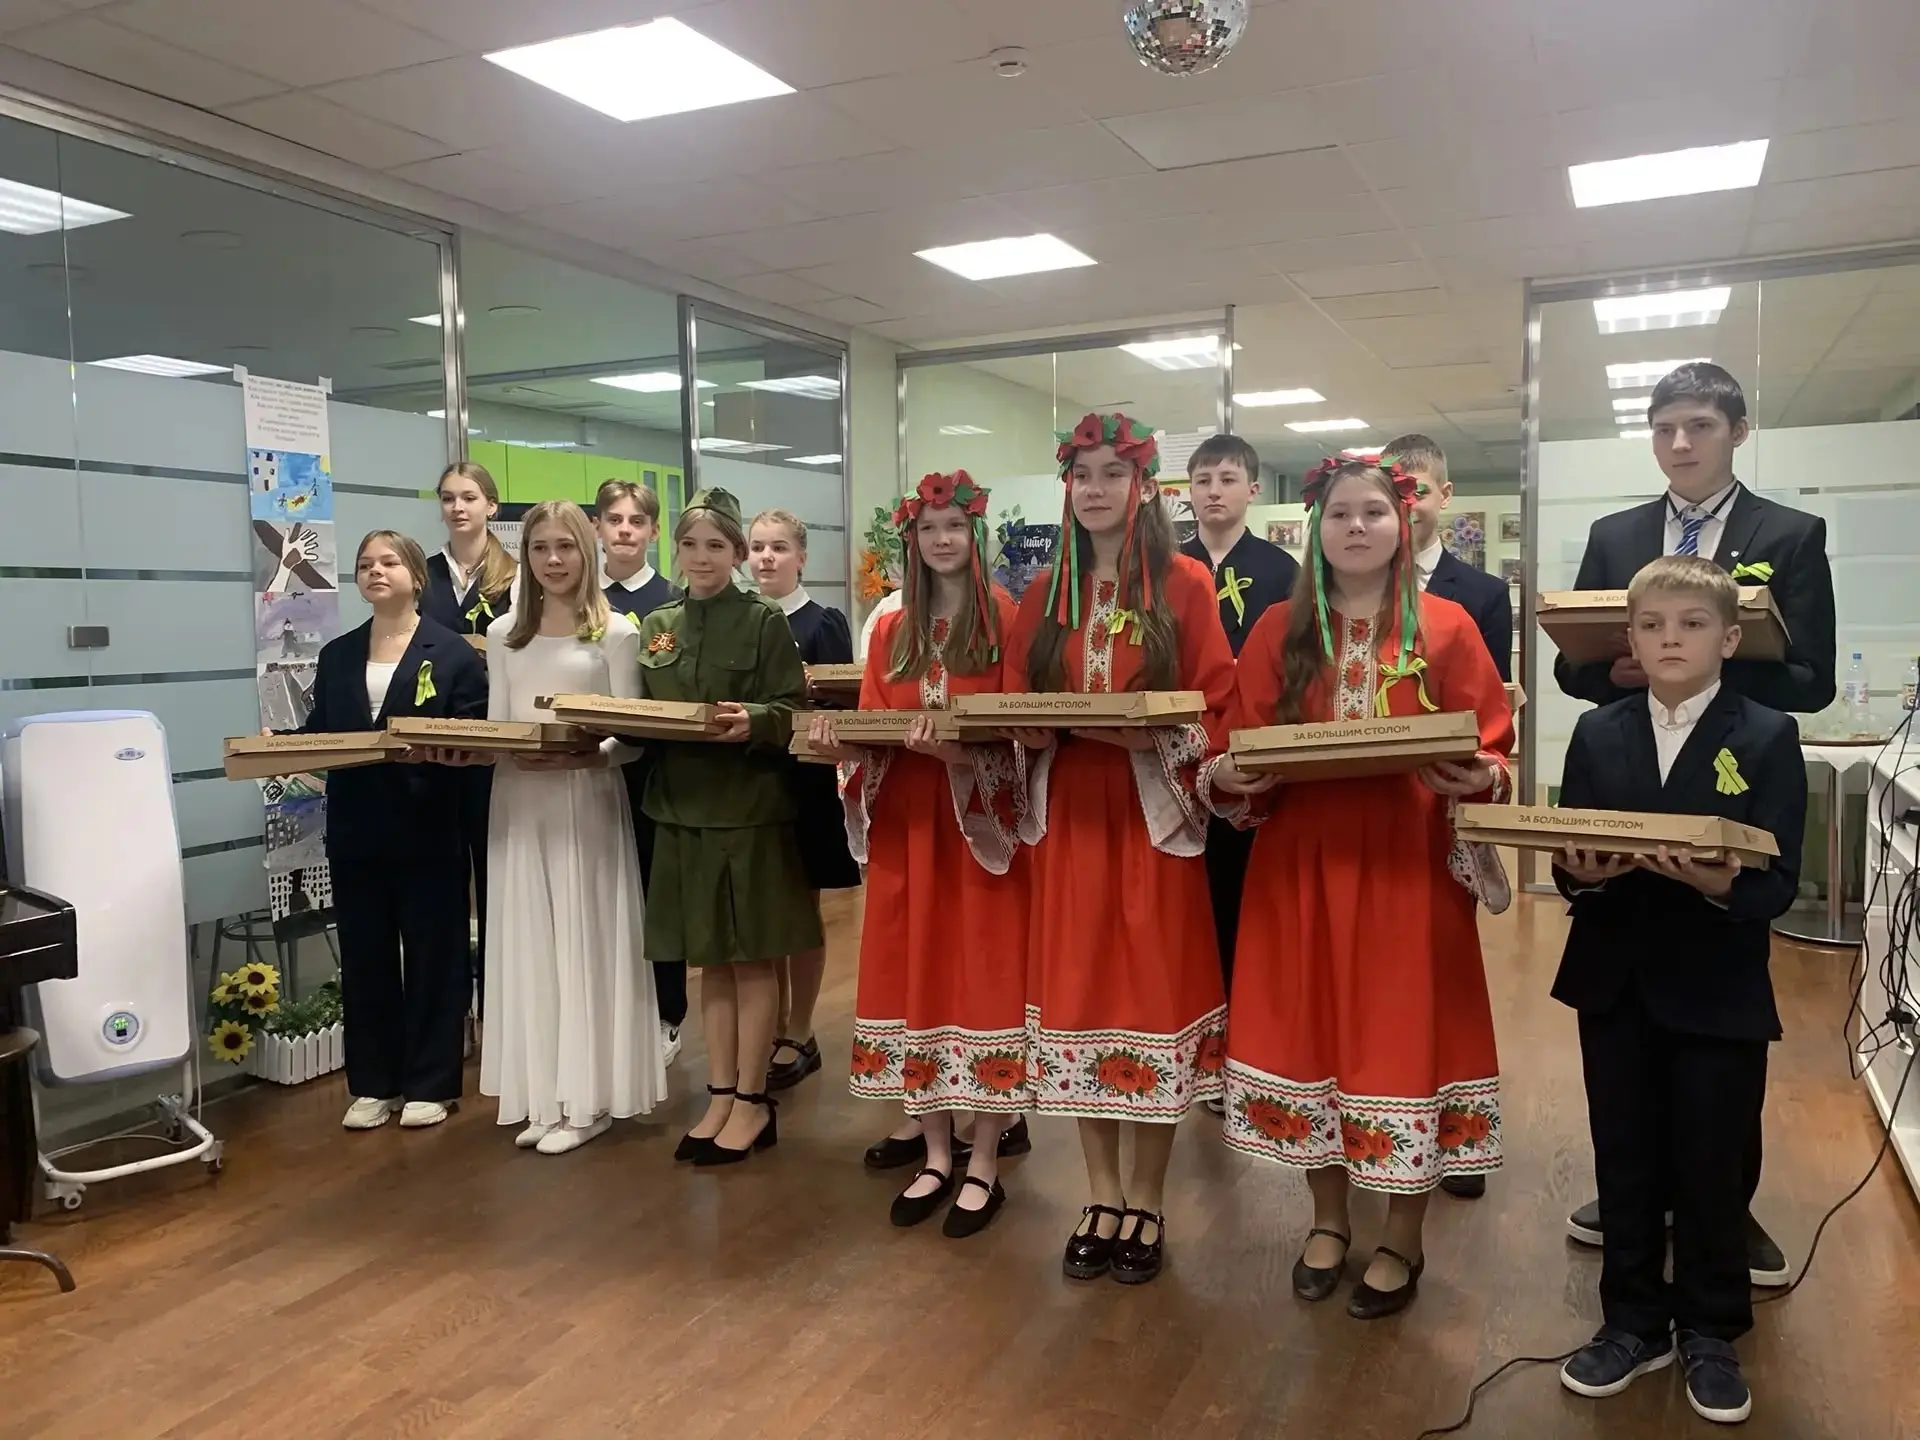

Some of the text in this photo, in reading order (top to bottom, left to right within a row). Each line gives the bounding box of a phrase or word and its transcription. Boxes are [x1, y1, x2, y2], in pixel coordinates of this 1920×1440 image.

[998, 700, 1091, 709] ЗА БОЛЬШИМ СТОЛОМ
[844, 717, 880, 725] БОЛЬШИМ
[1293, 725, 1410, 740] ЗА БОЛЬШИМ СТОЛОМ
[1518, 814, 1644, 830] ЗА БОЛЬШИМ СТОЛОМ
